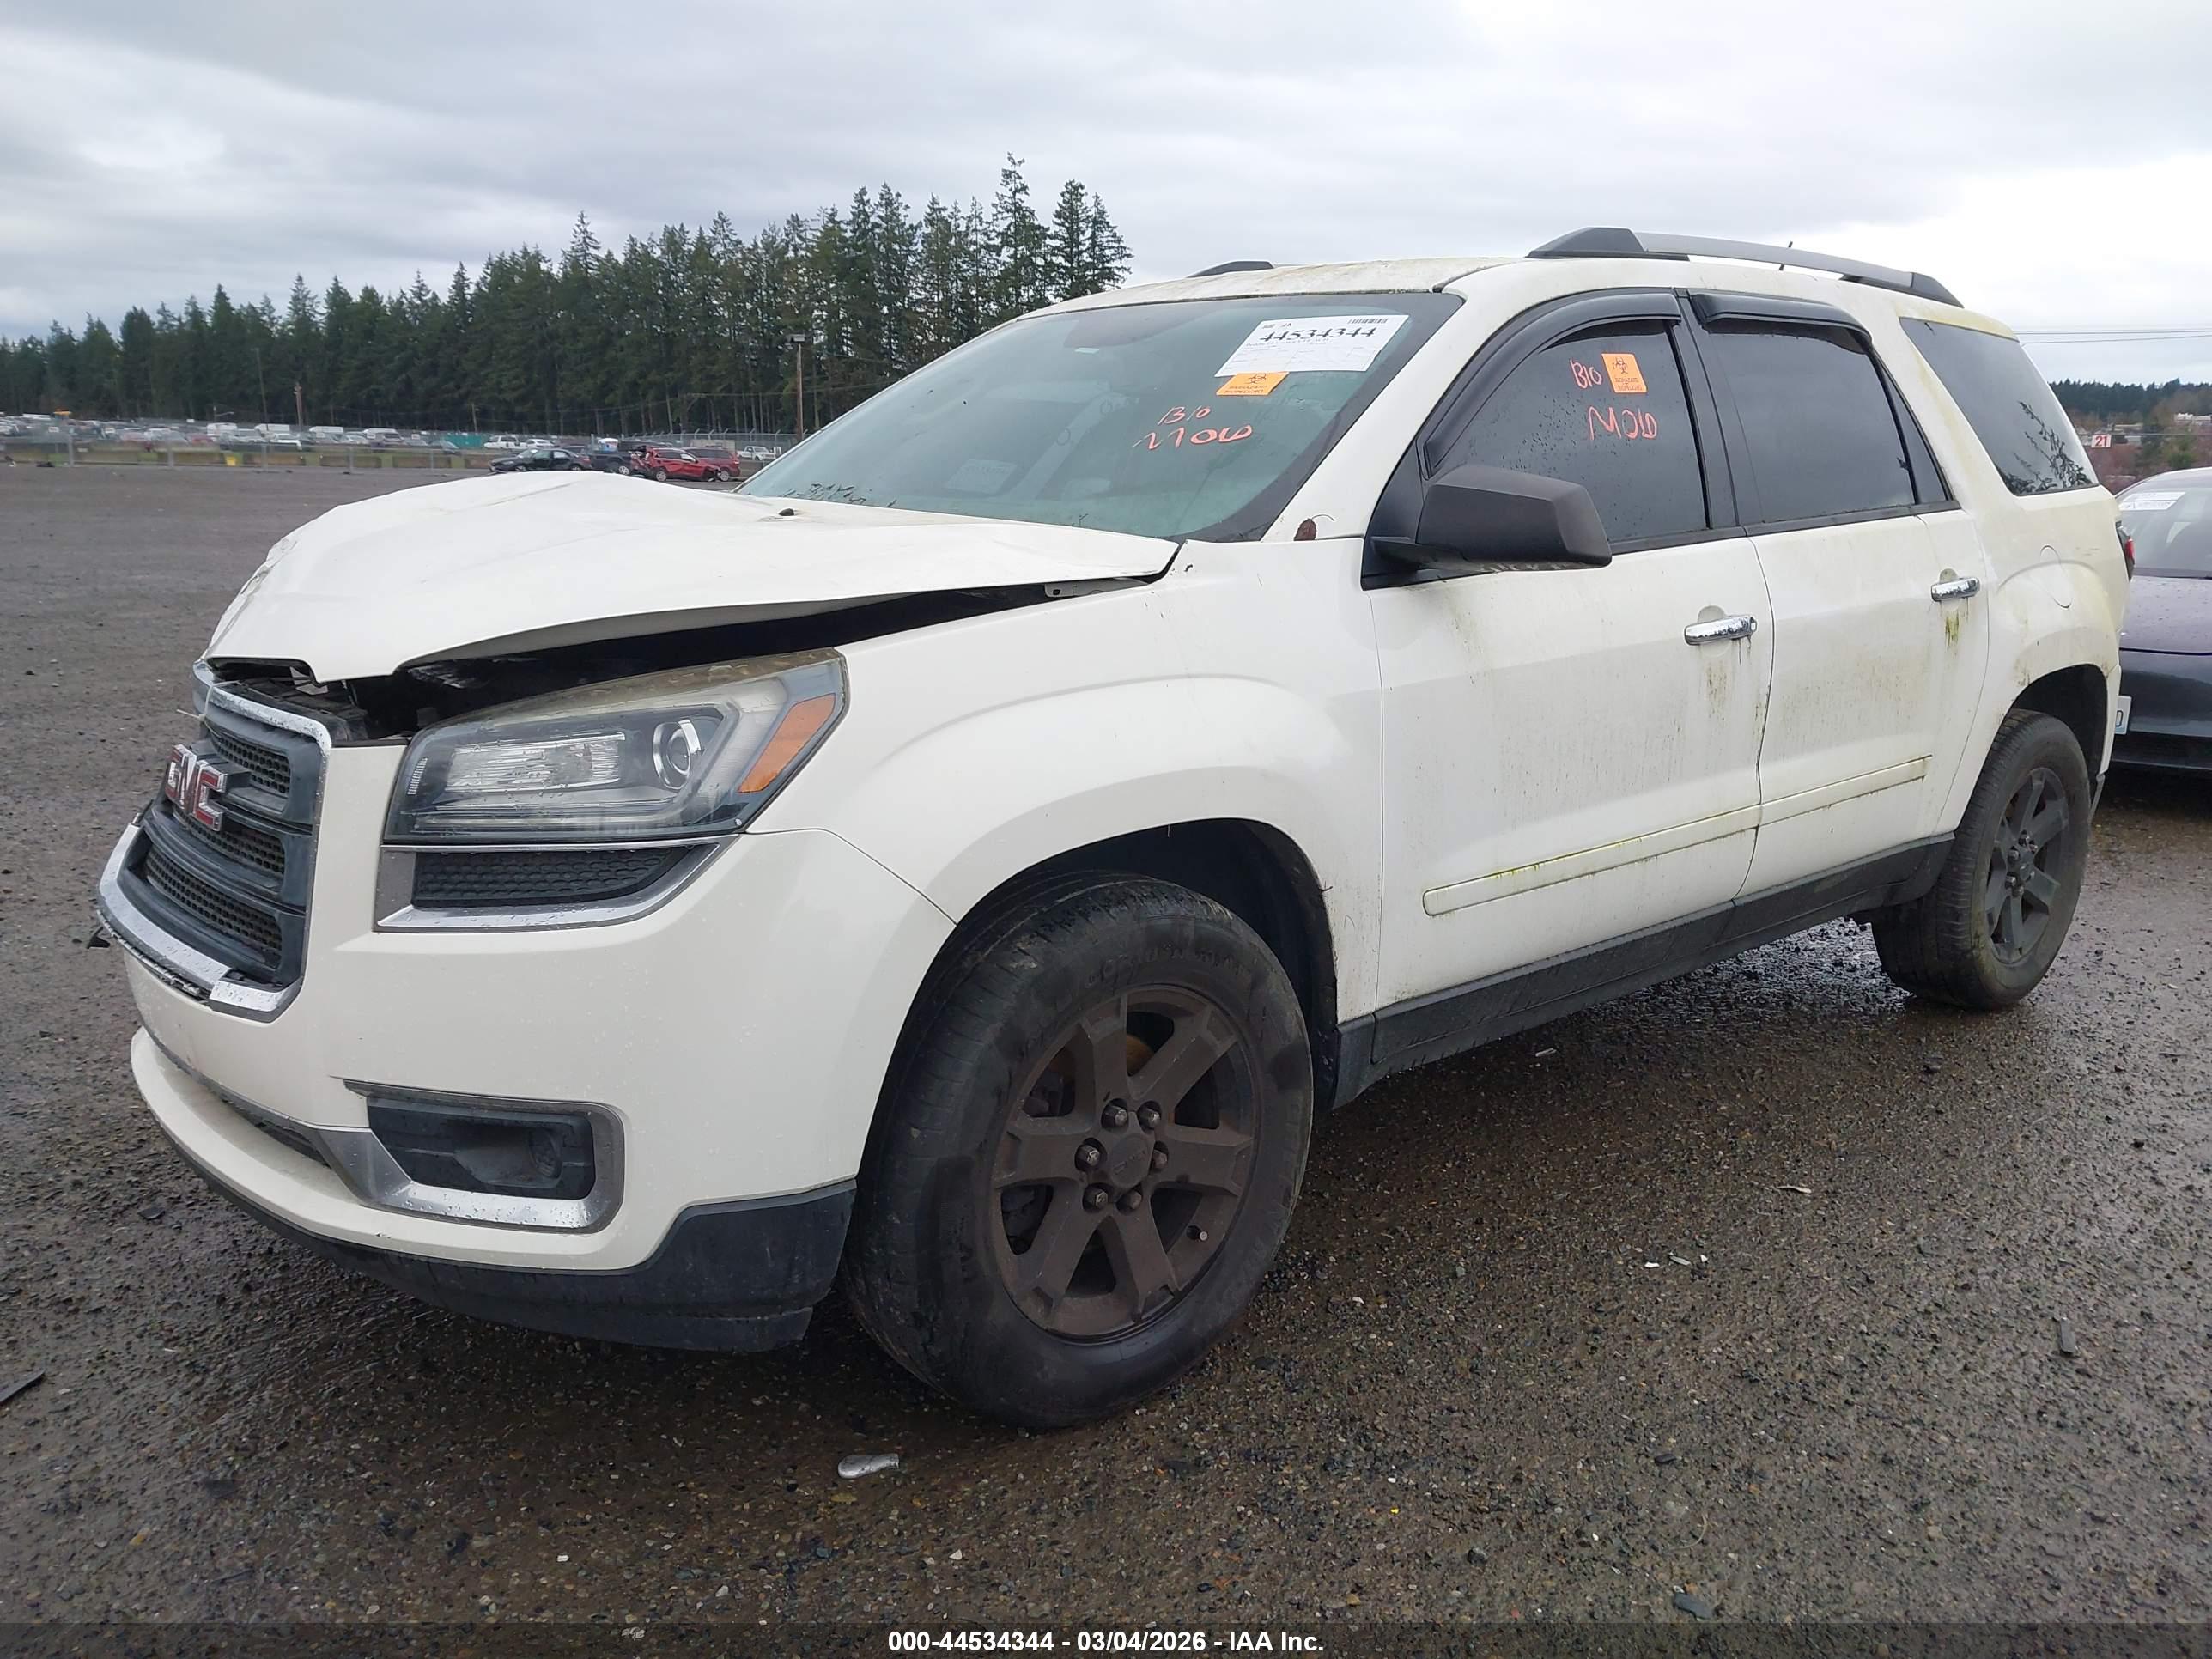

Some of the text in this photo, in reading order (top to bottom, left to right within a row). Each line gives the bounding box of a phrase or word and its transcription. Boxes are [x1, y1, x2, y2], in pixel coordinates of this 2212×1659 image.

[1259, 326, 1377, 342] 44534344
[1570, 359, 1603, 389] BIO
[2095, 435, 2108, 447] 21
